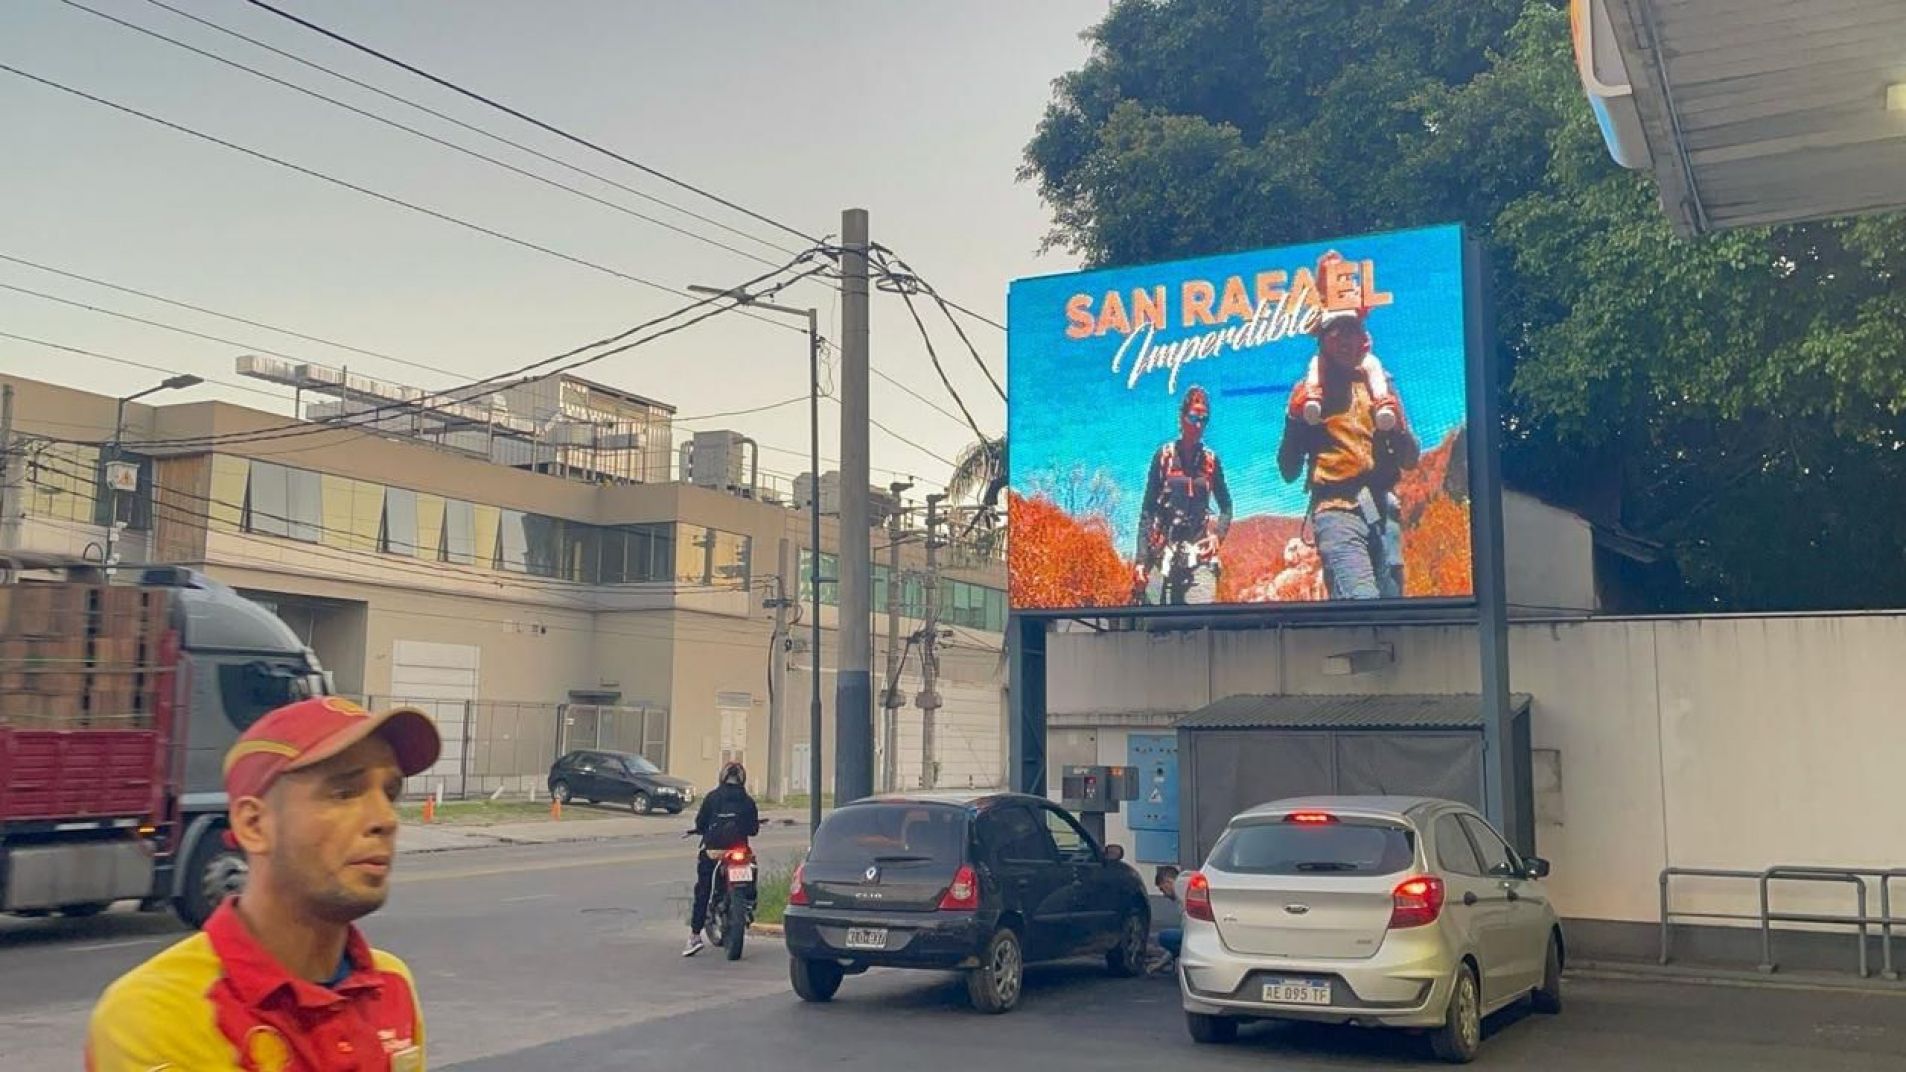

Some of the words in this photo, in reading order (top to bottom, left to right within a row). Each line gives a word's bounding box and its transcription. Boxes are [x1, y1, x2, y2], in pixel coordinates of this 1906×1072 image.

[1066, 285, 1166, 339] SAN
[1182, 258, 1394, 326] RAFAEL
[1111, 287, 1323, 395] Imperdible
[1265, 986, 1280, 999] AE
[1284, 986, 1308, 1000] 095
[1312, 988, 1328, 1002] TF
